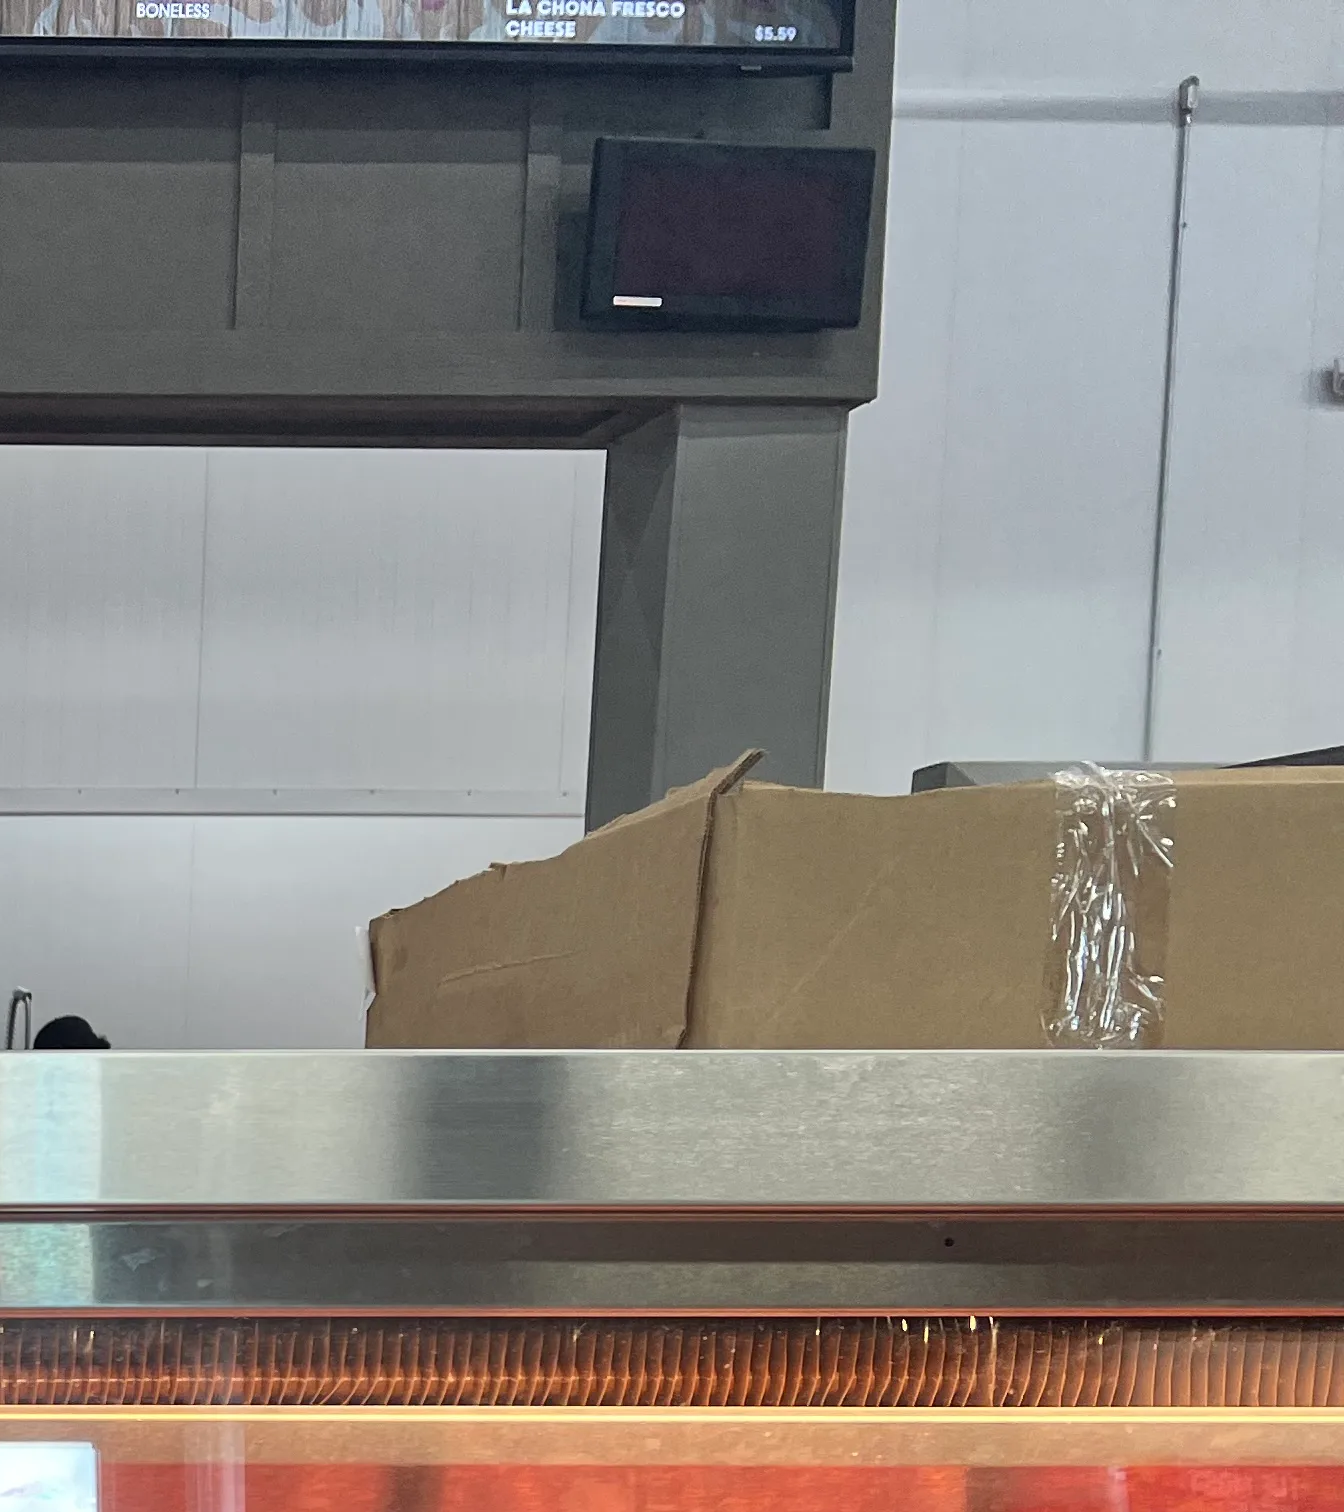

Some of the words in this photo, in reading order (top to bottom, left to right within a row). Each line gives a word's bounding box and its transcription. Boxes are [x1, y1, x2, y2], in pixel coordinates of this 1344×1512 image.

[136, 2, 210, 19] BONELESS
[505, 0, 533, 16] LA
[536, 0, 606, 17] CHONA
[612, 0, 686, 18] FRESCO
[505, 20, 576, 38] CHEESE
